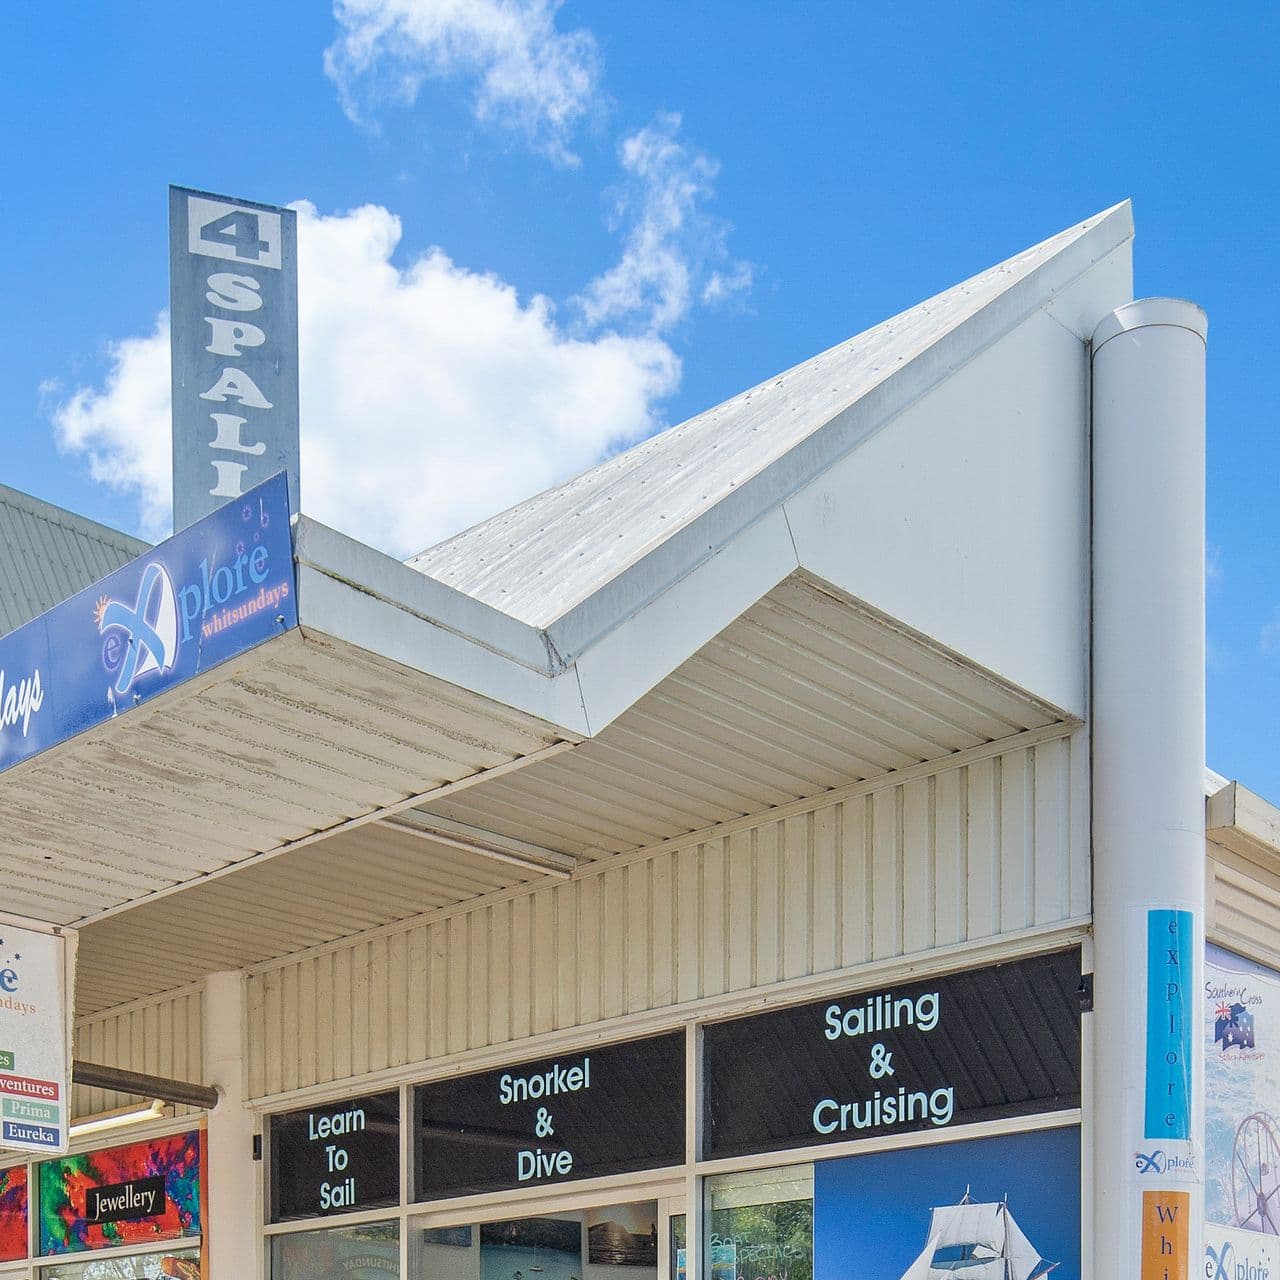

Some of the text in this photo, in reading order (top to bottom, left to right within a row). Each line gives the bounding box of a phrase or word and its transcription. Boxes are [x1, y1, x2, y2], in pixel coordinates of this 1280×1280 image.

[201, 580, 289, 638] whitsundays
[824, 992, 940, 1041] Sailing
[1165, 918, 1179, 1129] explore
[869, 1042, 894, 1079] &
[499, 1058, 590, 1105] Snorkel
[11, 1100, 51, 1120] Prima
[308, 1108, 365, 1140] Learn
[535, 1107, 554, 1138] &
[812, 1087, 954, 1134] Cruising
[8, 1124, 55, 1143] Eureka
[326, 1145, 348, 1172] To
[518, 1150, 573, 1181] Dive
[93, 1183, 157, 1222] Jewellery
[320, 1179, 355, 1210] Sail
